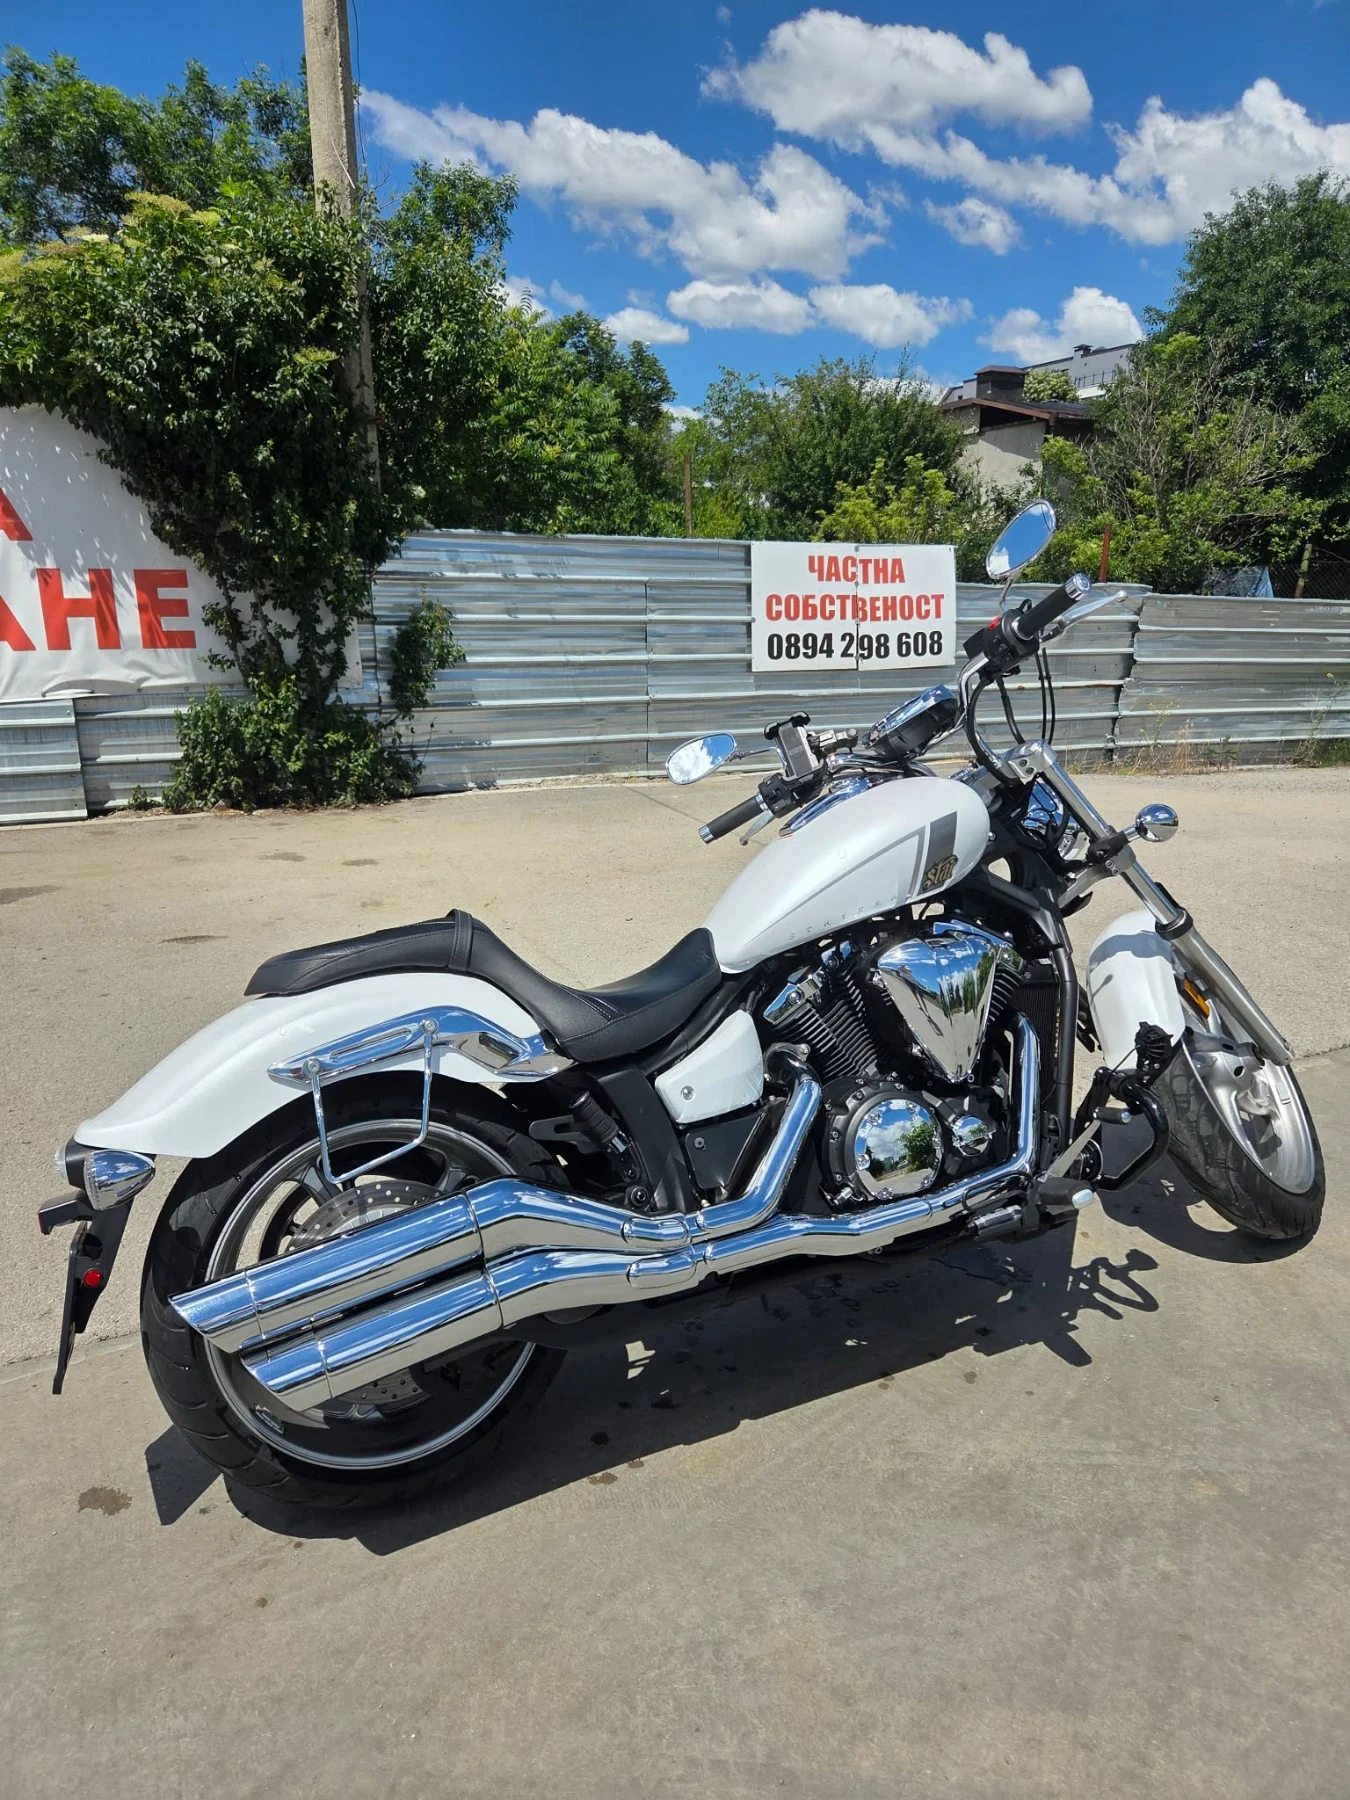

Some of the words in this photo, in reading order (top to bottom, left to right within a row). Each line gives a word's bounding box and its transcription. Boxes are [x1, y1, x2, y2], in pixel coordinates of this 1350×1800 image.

[808, 555, 906, 584] ЧАСТНА
[765, 594, 945, 622] СОБСТВЕНОСТ
[767, 633, 834, 660] 0894
[840, 632, 890, 660] 298
[897, 630, 943, 658] 608
